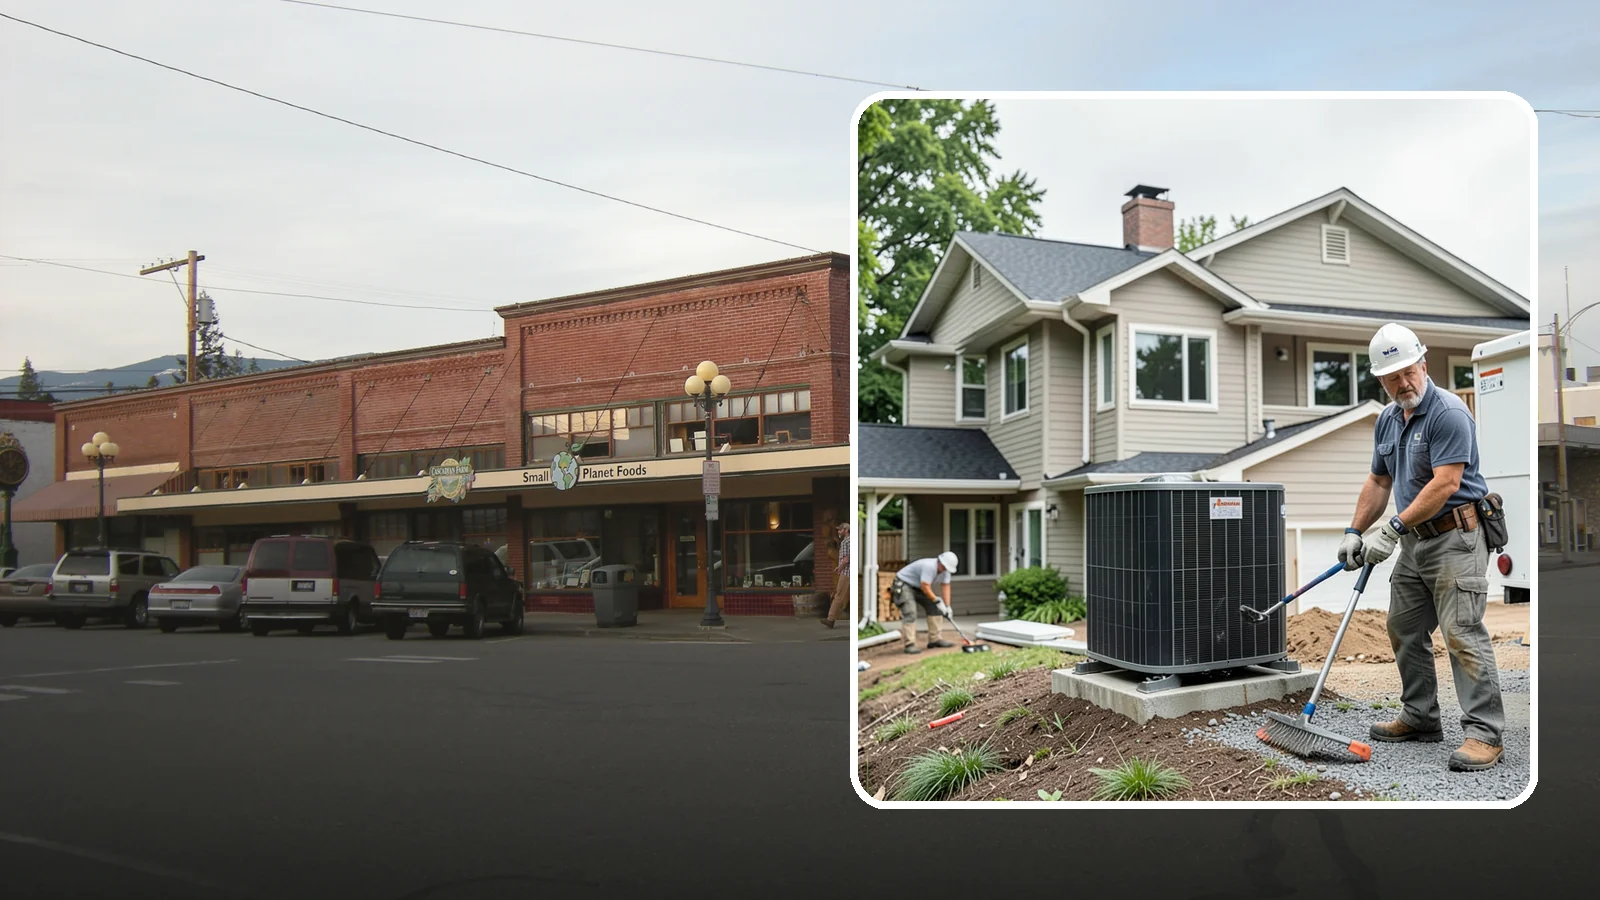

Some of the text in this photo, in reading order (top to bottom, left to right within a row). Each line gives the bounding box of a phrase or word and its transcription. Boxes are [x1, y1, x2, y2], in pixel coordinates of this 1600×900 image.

[523, 464, 647, 483] Small Planet Foods
